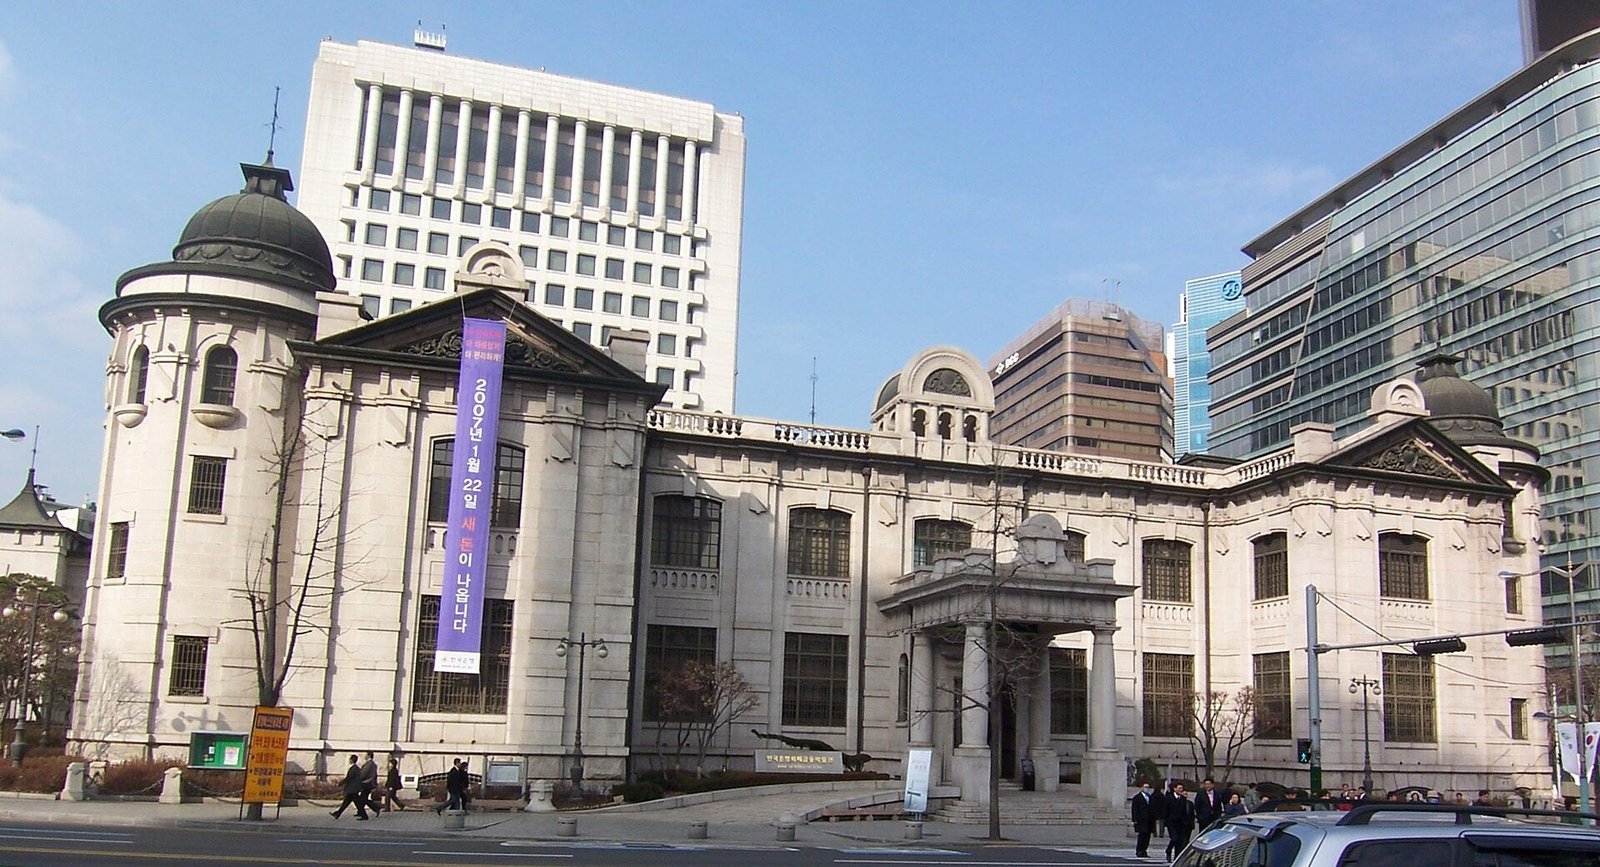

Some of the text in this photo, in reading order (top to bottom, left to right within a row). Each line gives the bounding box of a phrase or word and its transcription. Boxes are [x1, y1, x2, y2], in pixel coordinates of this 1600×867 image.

[464, 350, 472, 359] 더
[469, 379, 487, 441] 2007년
[467, 445, 480, 473] 1월
[461, 517, 475, 532] 새
[453, 573, 471, 633] 나옵니다
